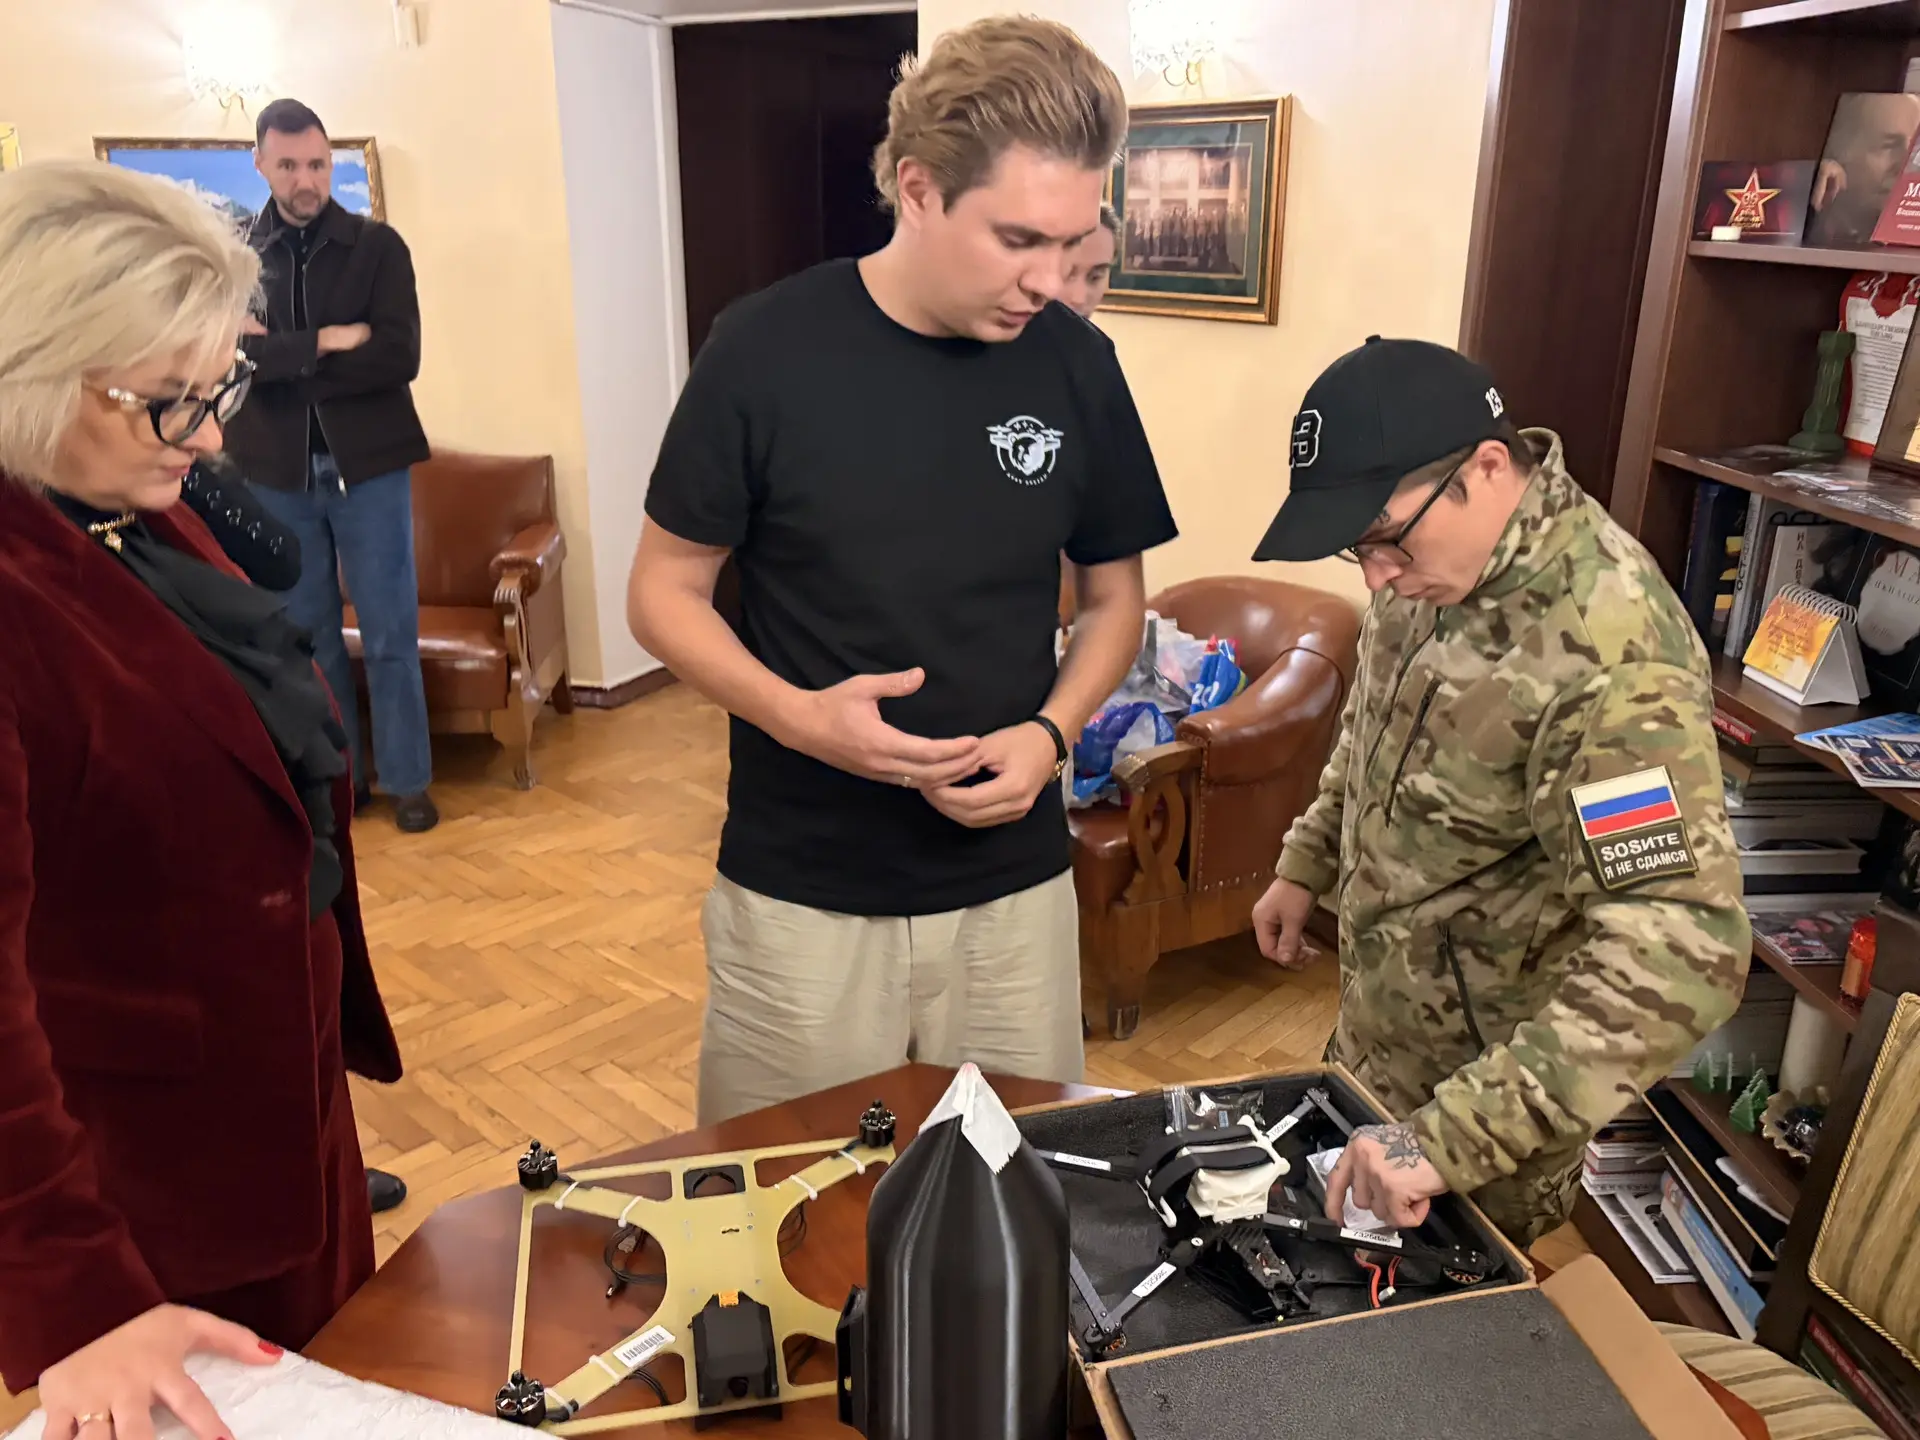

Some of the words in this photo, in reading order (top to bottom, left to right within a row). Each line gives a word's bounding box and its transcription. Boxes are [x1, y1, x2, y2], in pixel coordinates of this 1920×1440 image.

[1485, 387, 1504, 419] 13
[1604, 865, 1614, 880] Я
[1616, 860, 1634, 876] НЕ
[1636, 850, 1689, 870] СДАМСЯ
